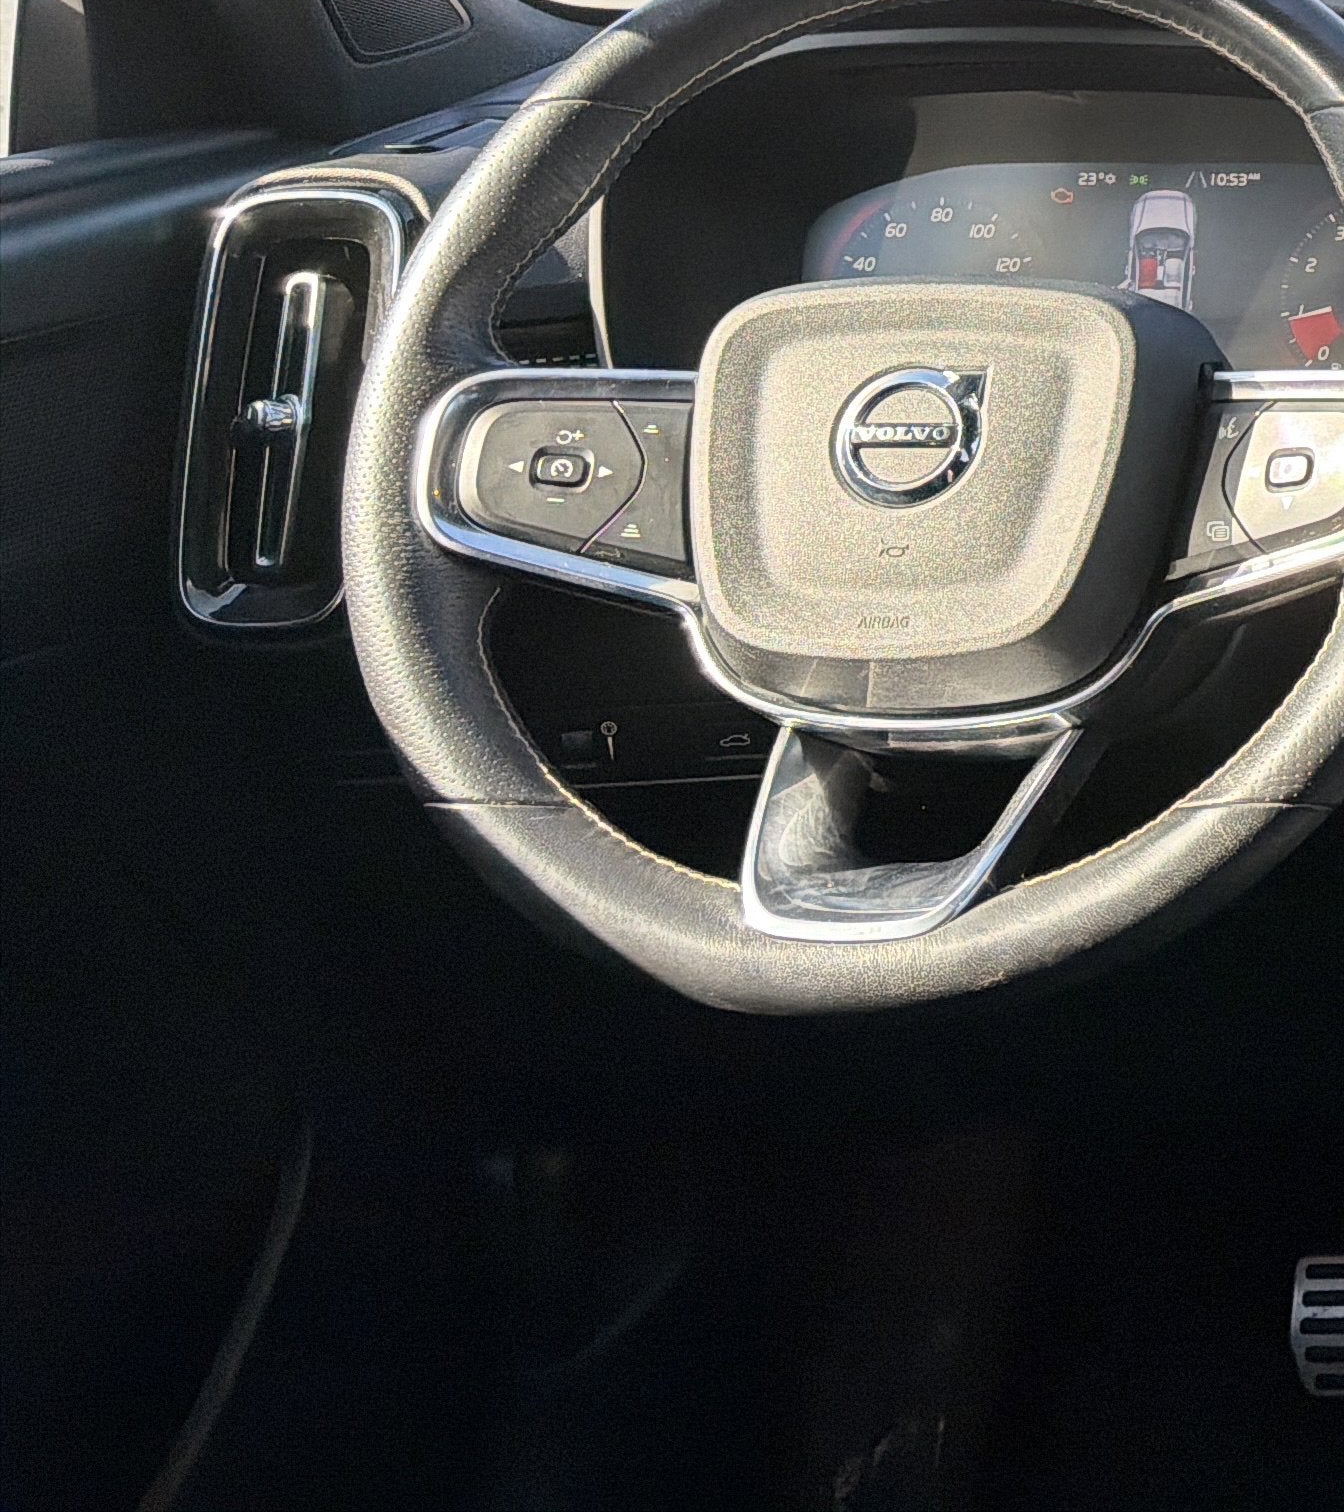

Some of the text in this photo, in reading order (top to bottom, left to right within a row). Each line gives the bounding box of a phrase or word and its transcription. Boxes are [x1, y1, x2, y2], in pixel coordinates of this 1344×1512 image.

[930, 208, 954, 222] 80
[884, 223, 907, 238] 60
[969, 224, 996, 239] 100
[853, 256, 876, 272] 40
[995, 258, 1021, 272] 120
[1305, 257, 1317, 273] 2
[1317, 346, 1330, 361] 0
[853, 425, 951, 441] VOLVO
[857, 615, 911, 630] AIRBAG
